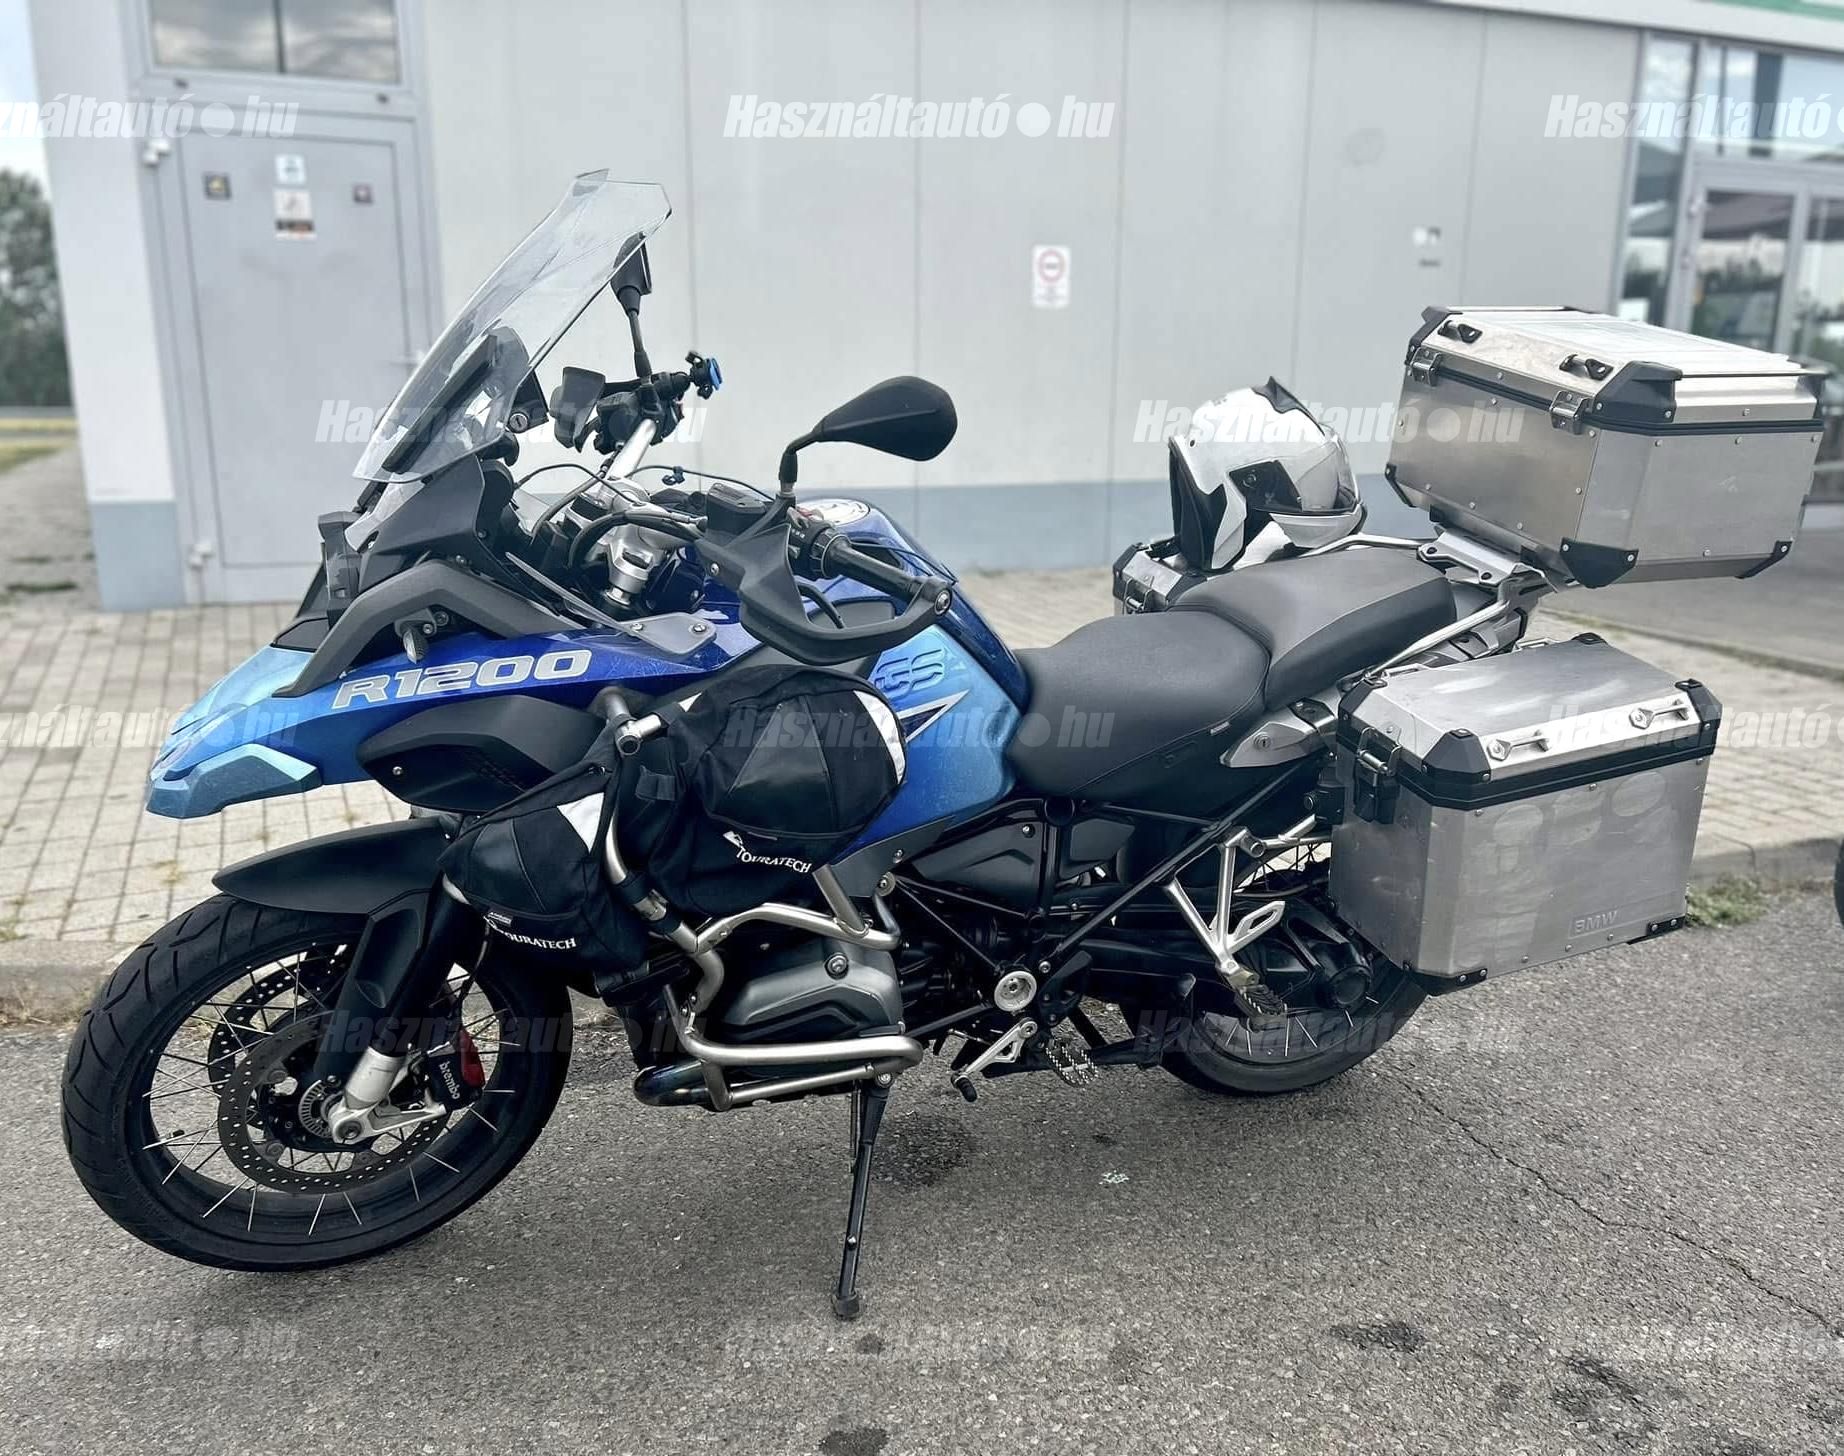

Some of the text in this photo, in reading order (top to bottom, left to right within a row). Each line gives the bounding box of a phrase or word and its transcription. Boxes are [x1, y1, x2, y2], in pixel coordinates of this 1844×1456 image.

[331, 649, 592, 710] R1200
[736, 845, 812, 873] TOURATECH
[1574, 909, 1618, 934] BMW
[438, 1060, 461, 1100] brembo
